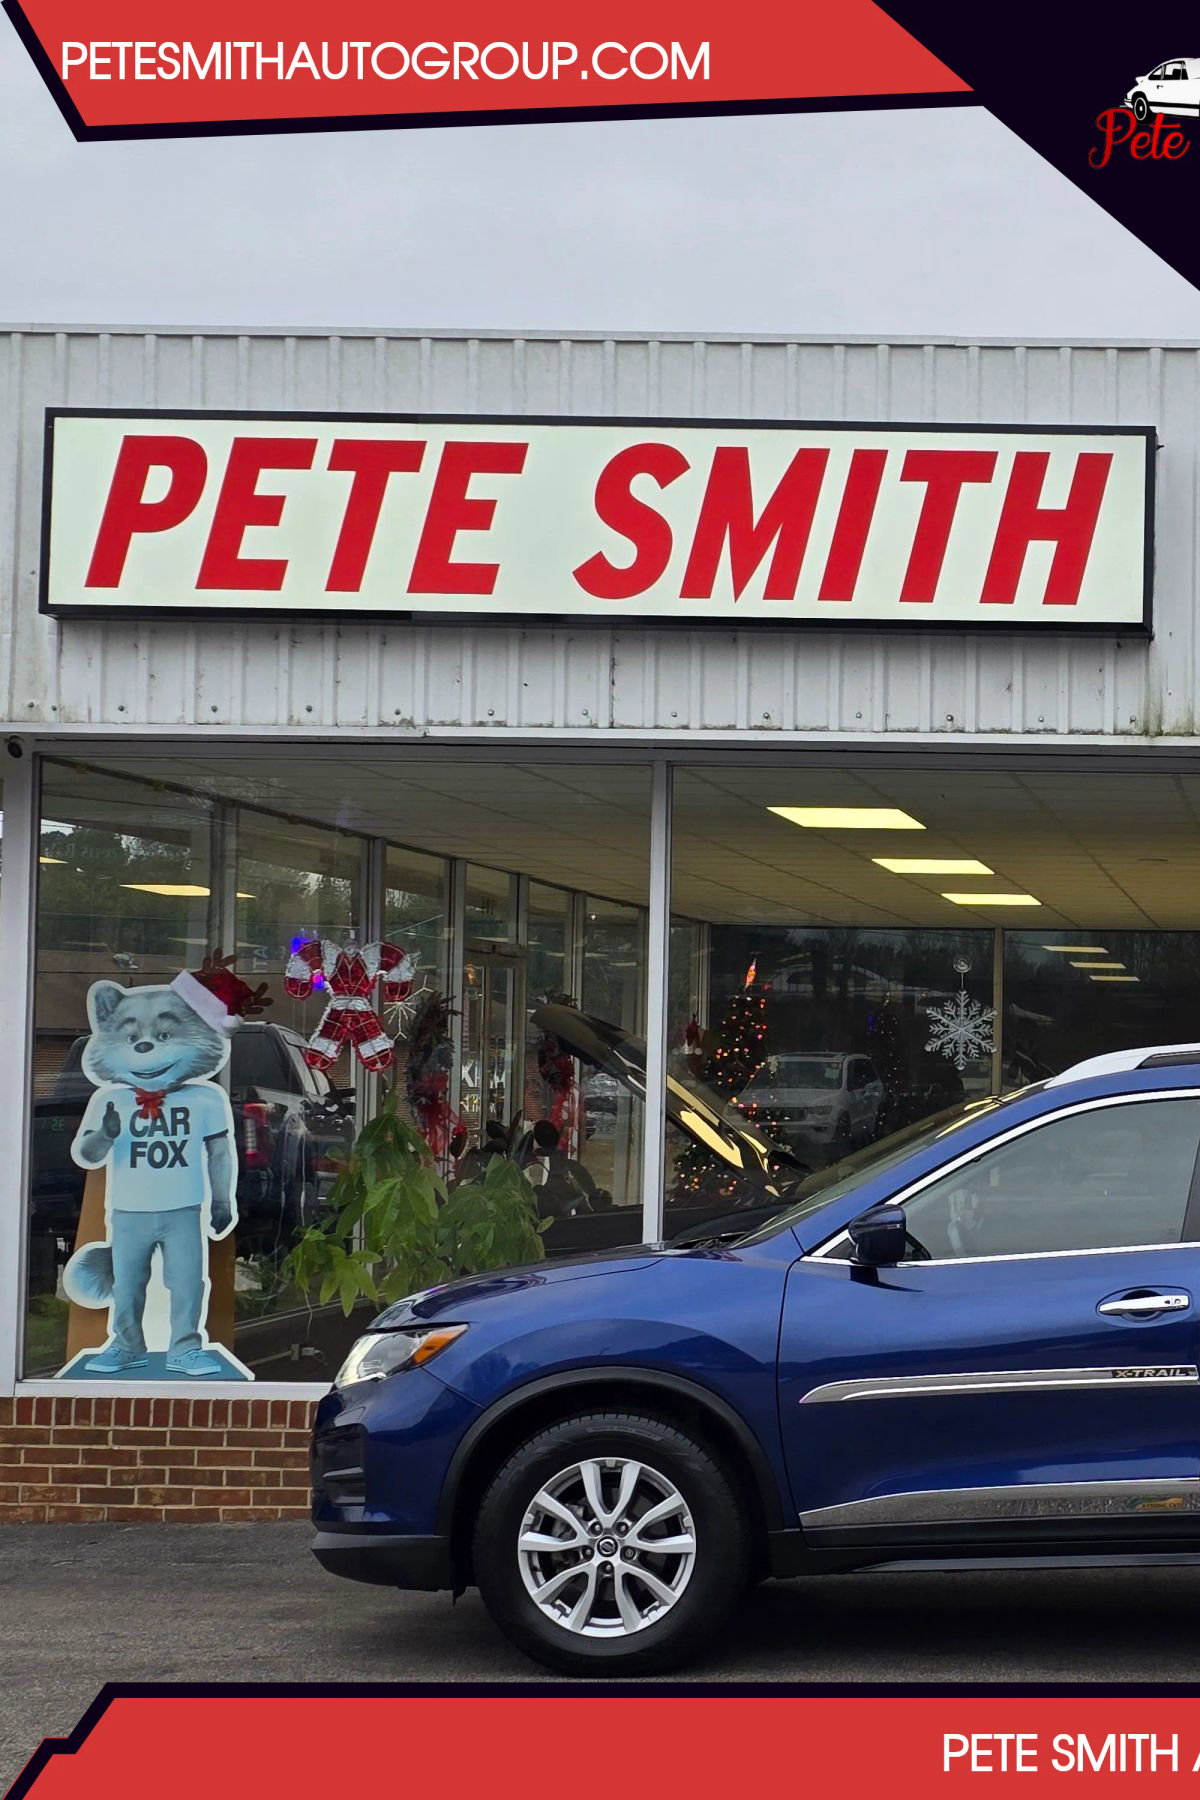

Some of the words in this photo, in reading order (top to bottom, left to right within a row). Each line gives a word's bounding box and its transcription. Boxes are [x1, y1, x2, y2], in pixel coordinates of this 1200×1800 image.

[86, 435, 529, 595] PETE
[573, 443, 1112, 605] SMITH
[129, 1106, 191, 1138] CAR
[129, 1139, 189, 1169] FOX
[1115, 1368, 1187, 1378] X-TRAIL
